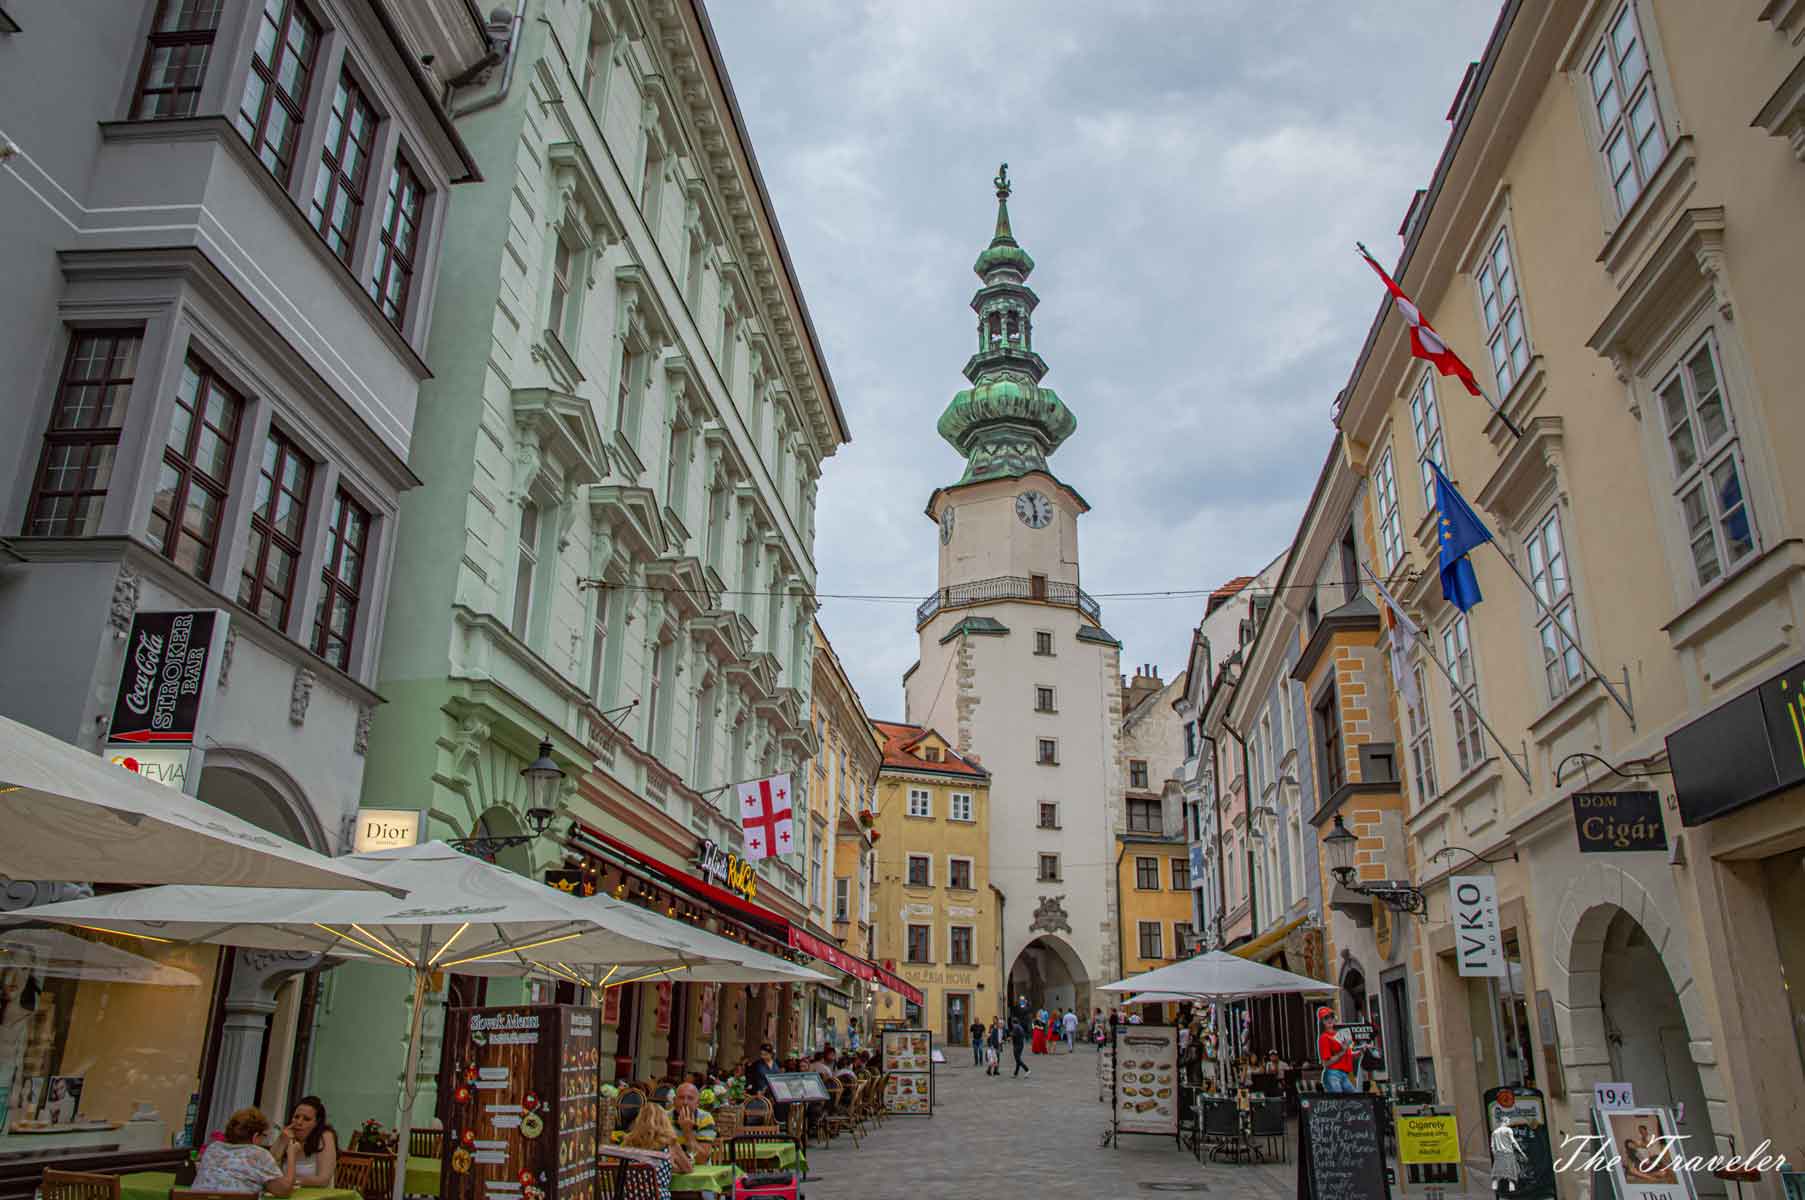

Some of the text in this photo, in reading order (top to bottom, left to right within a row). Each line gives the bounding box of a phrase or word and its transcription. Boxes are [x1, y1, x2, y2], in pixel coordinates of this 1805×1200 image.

[152, 613, 194, 729] STROKER
[180, 647, 206, 696] BAR
[1579, 795, 1617, 808] DOM
[366, 822, 409, 839] Dior
[1582, 815, 1660, 848] Cigár
[1457, 883, 1489, 969] IVKO
[1485, 895, 1497, 957] WOMAN
[1408, 1120, 1446, 1130] Cigarety
